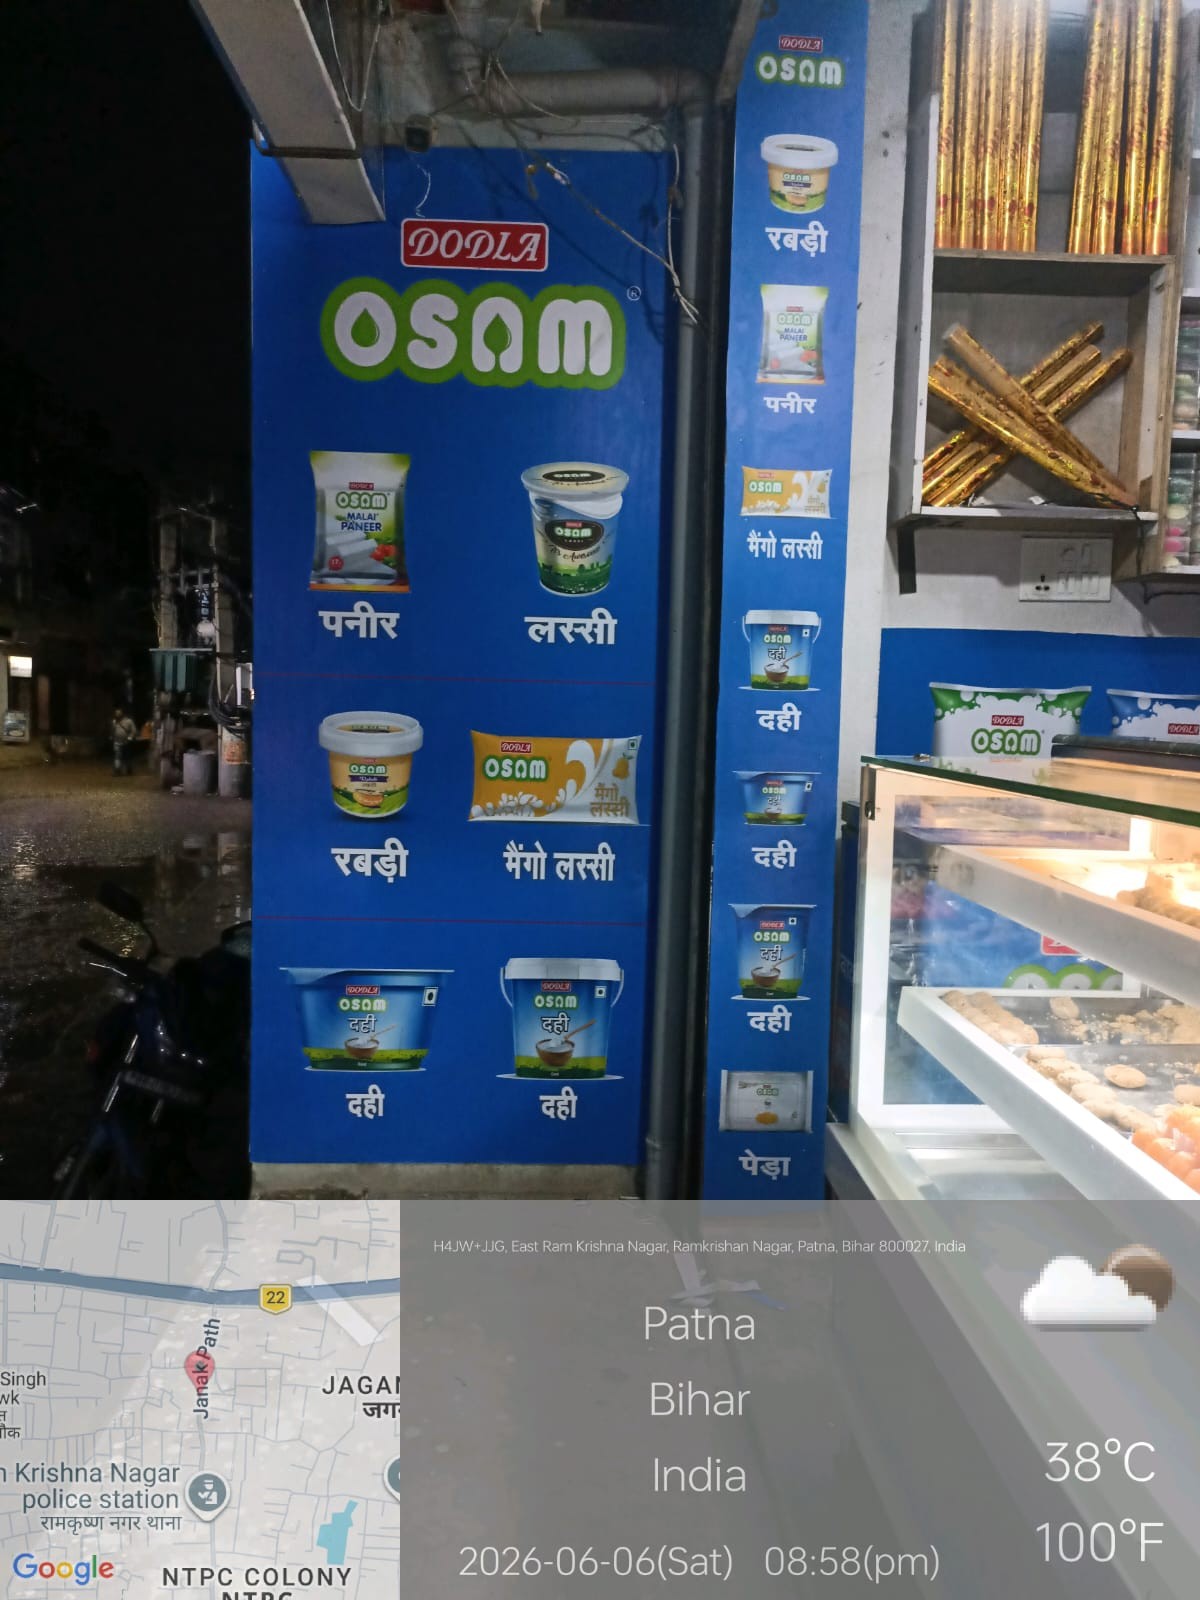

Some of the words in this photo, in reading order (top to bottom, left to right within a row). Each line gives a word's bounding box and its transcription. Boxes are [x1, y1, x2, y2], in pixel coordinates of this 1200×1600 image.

[781, 38, 820, 49] DODLA
[758, 55, 841, 85] OSAM
[408, 228, 541, 262] DODLA
[765, 221, 828, 257] रबड़ी
[334, 291, 612, 376] OSAM
[763, 392, 816, 414] पनीर
[337, 492, 387, 509] OSAM
[749, 481, 782, 493] OSAM
[341, 522, 382, 531] PANEER
[554, 527, 592, 537] OSAM
[747, 529, 777, 558] मैंगो
[781, 531, 823, 560] लस्सी
[318, 601, 399, 639] पनीर
[524, 607, 617, 644] लस्सी
[756, 702, 802, 733] दही
[501, 743, 531, 752] DODLA
[973, 730, 1040, 754] OSAM
[484, 757, 547, 779] OSAM
[331, 838, 408, 882] रबड़ी
[503, 841, 547, 880] मैंगो
[554, 842, 615, 881] लस्सी
[751, 839, 797, 870] दही
[754, 931, 789, 942] OSAM
[339, 998, 386, 1010] OSAM
[534, 995, 577, 1008] OSAM
[348, 1014, 377, 1033] दही
[541, 1012, 570, 1034] दही
[747, 1004, 792, 1033] दही
[346, 1085, 384, 1119] दही
[539, 1086, 577, 1120] दही
[738, 1149, 791, 1180] पेड़ा
